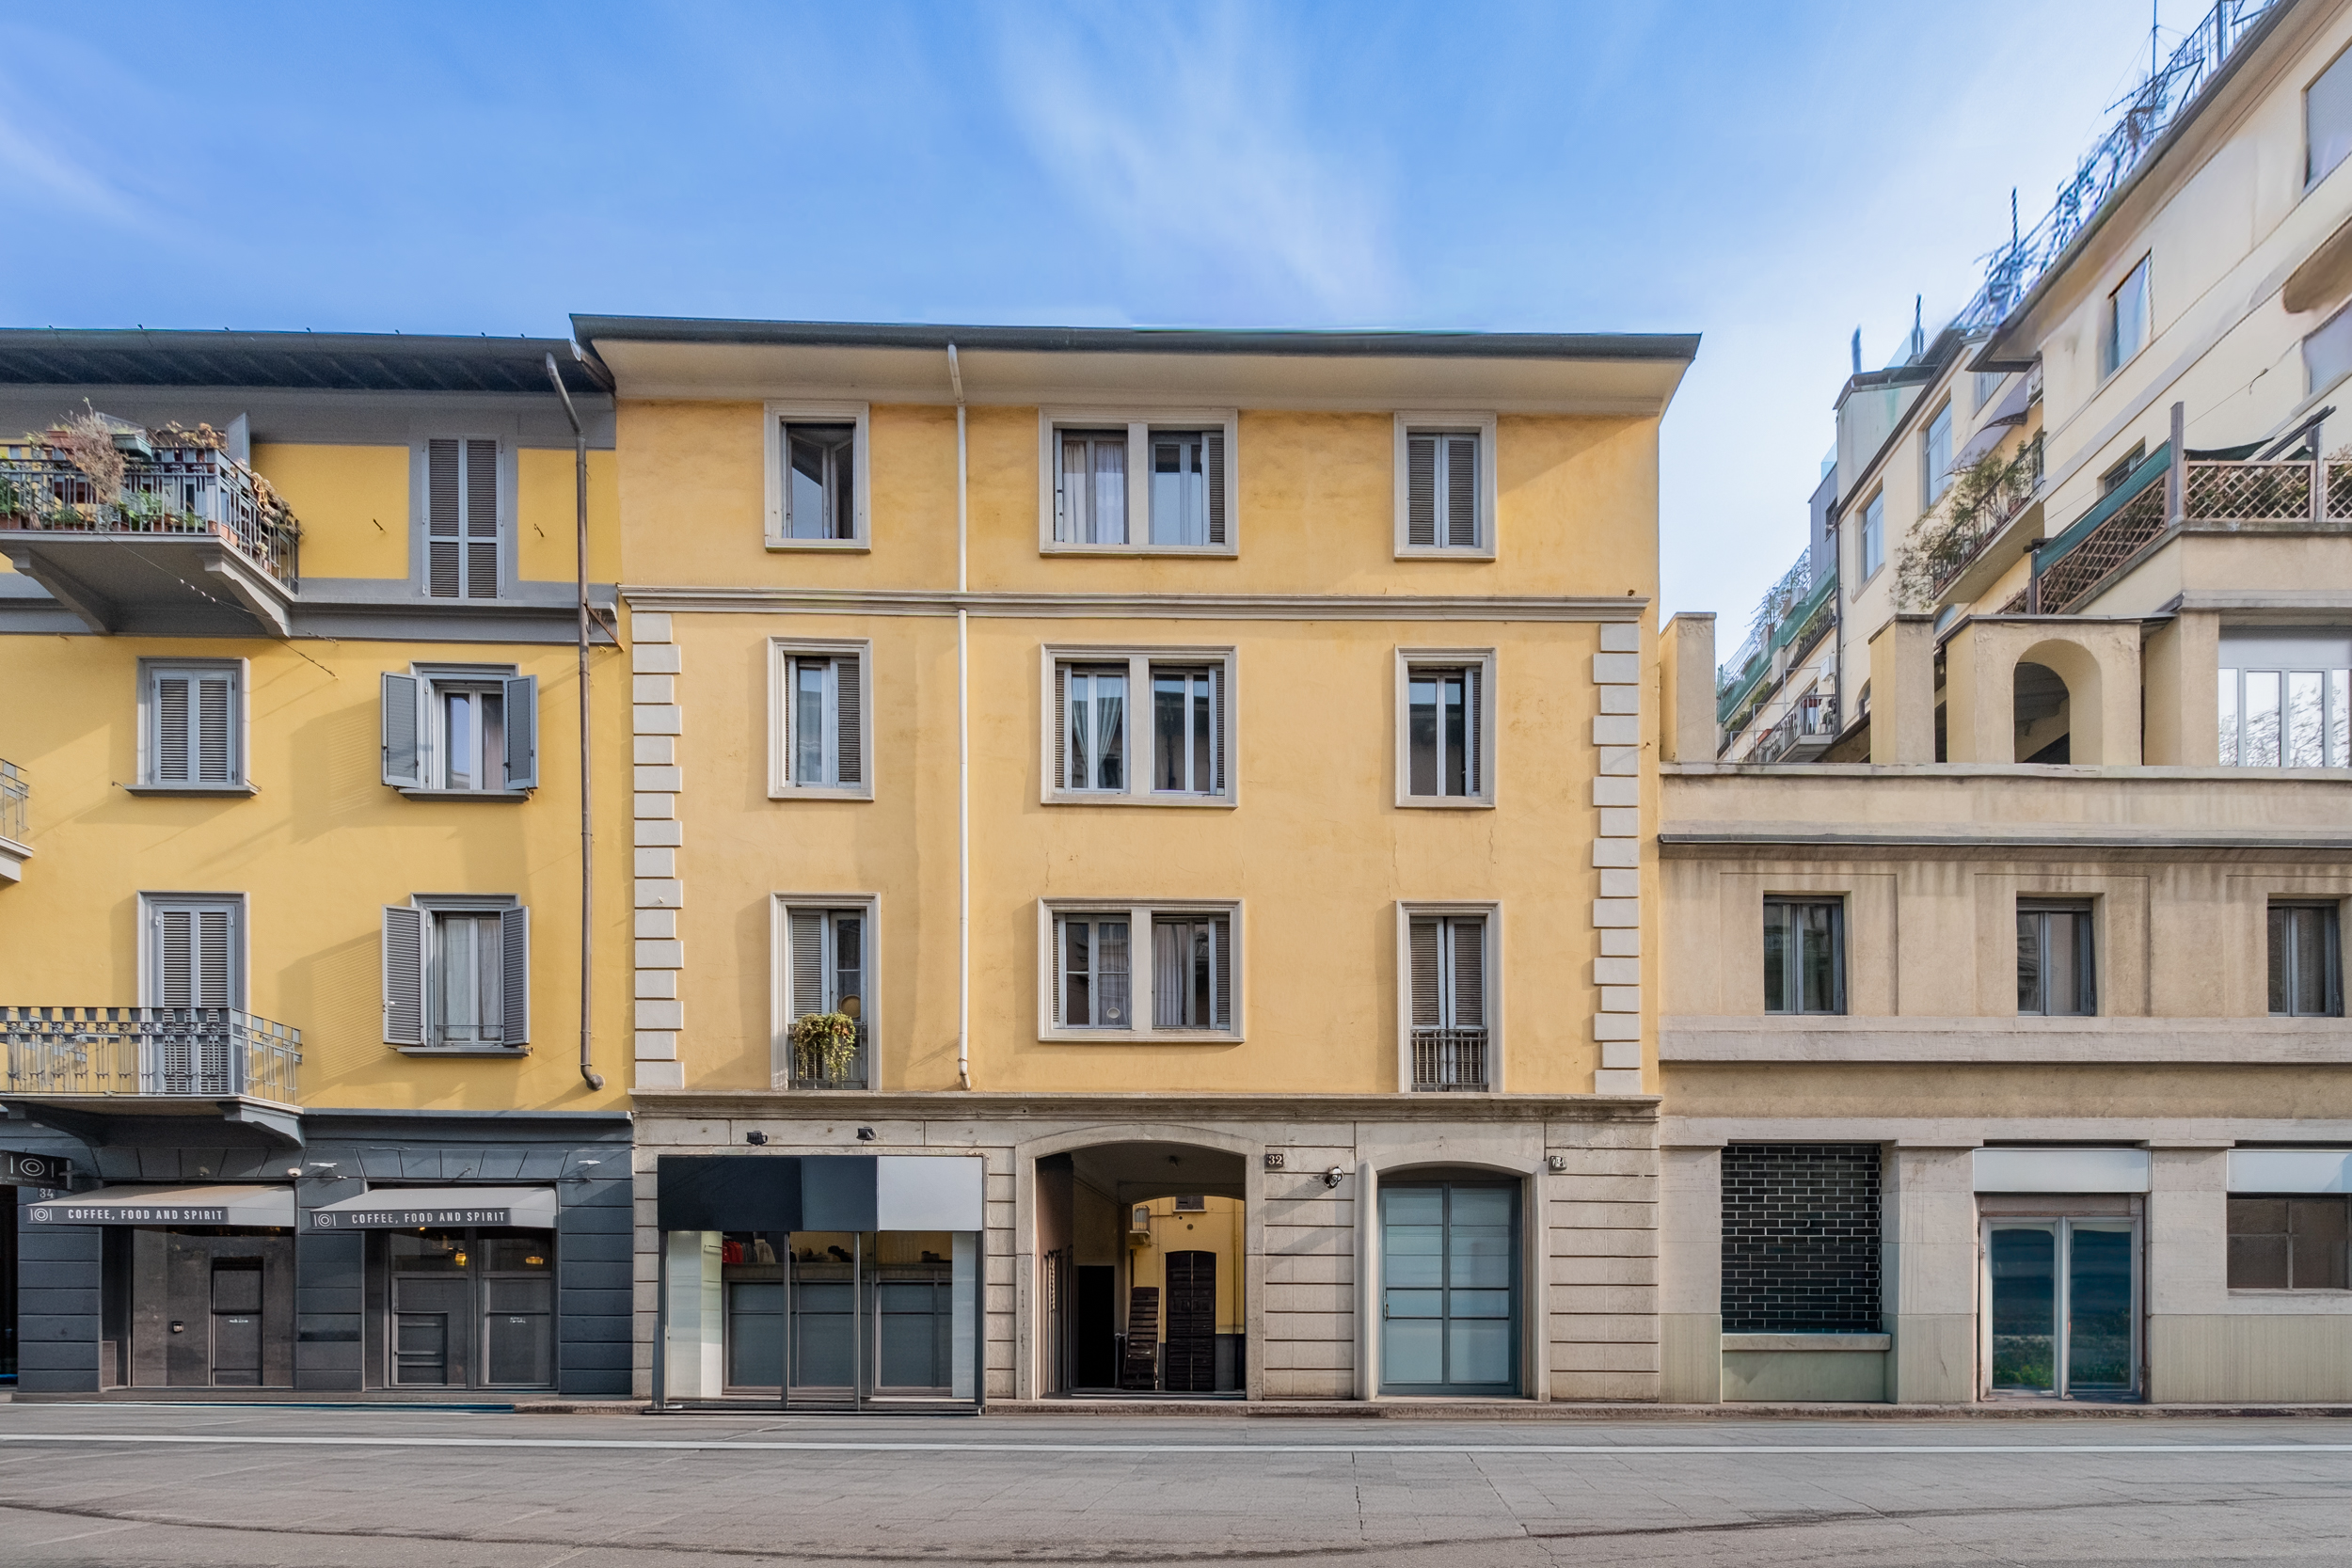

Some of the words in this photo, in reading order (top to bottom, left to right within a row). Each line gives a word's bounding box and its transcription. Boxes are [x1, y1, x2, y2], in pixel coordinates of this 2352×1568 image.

[1268, 1154, 1282, 1164] 32
[40, 1188, 54, 1198] 34
[68, 1209, 115, 1221] COFFEE,
[120, 1210, 150, 1220] FOOD
[156, 1210, 178, 1220] AND
[183, 1210, 222, 1220] SPIRIT
[352, 1213, 398, 1224] COFFEE,
[405, 1212, 433, 1222] FOOD
[439, 1212, 461, 1222] AND
[467, 1212, 504, 1222] SPIRIT
